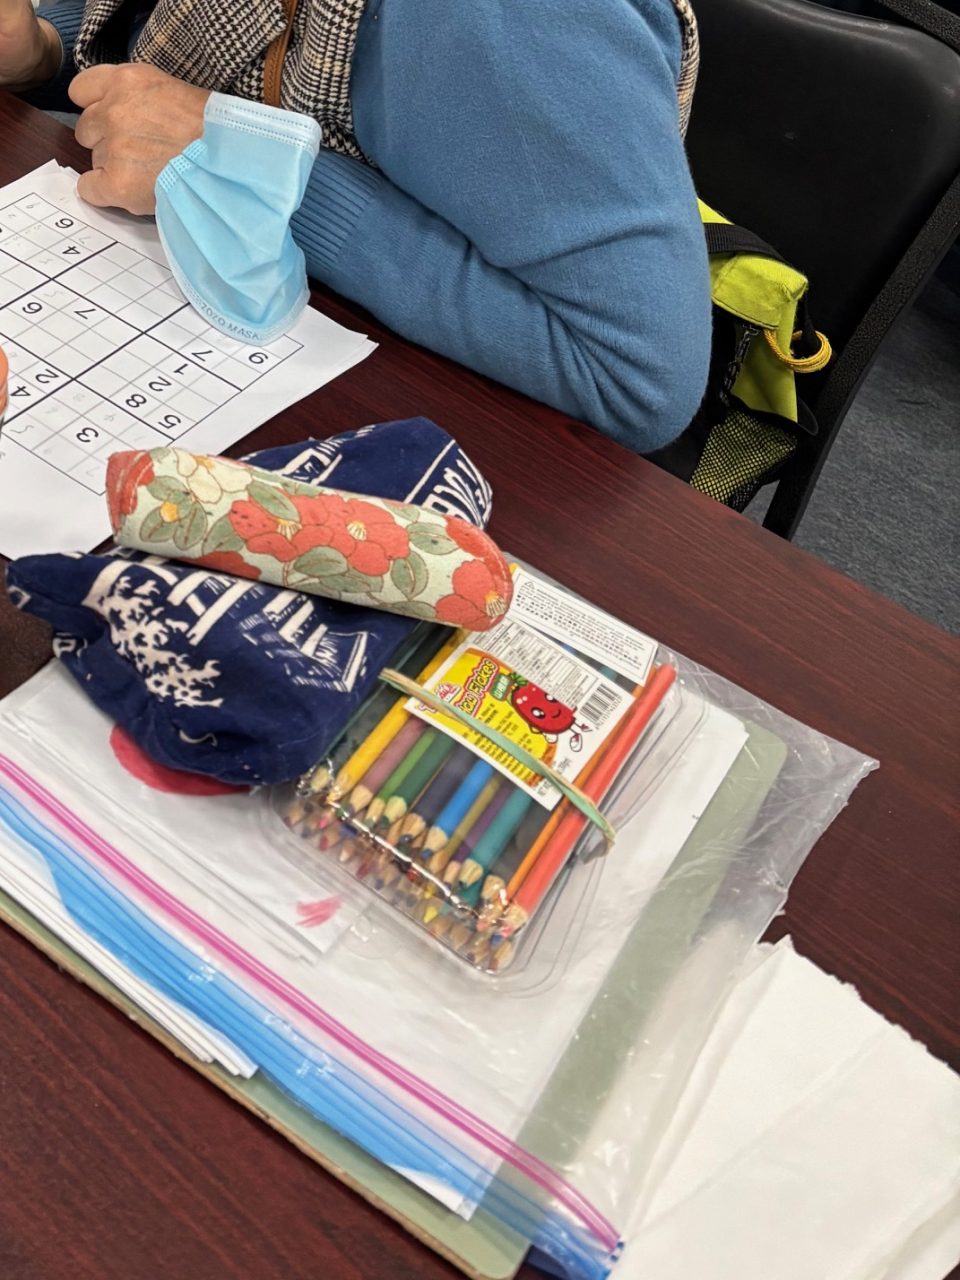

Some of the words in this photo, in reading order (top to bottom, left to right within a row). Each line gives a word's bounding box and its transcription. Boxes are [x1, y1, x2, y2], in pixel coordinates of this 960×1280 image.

[56, 217, 74, 229] 6
[62, 245, 81, 257] 4
[23, 301, 43, 315] 6
[149, 376, 172, 392] 2
[75, 307, 96, 319] 7
[174, 362, 189, 375] 1
[191, 350, 213, 362] 7
[36, 369, 59, 385] 2
[11, 385, 31, 398] 4
[76, 425, 99, 443] 3
[126, 392, 147, 408] 8
[158, 413, 181, 428] 5
[470, 658, 497, 694] Flakes
